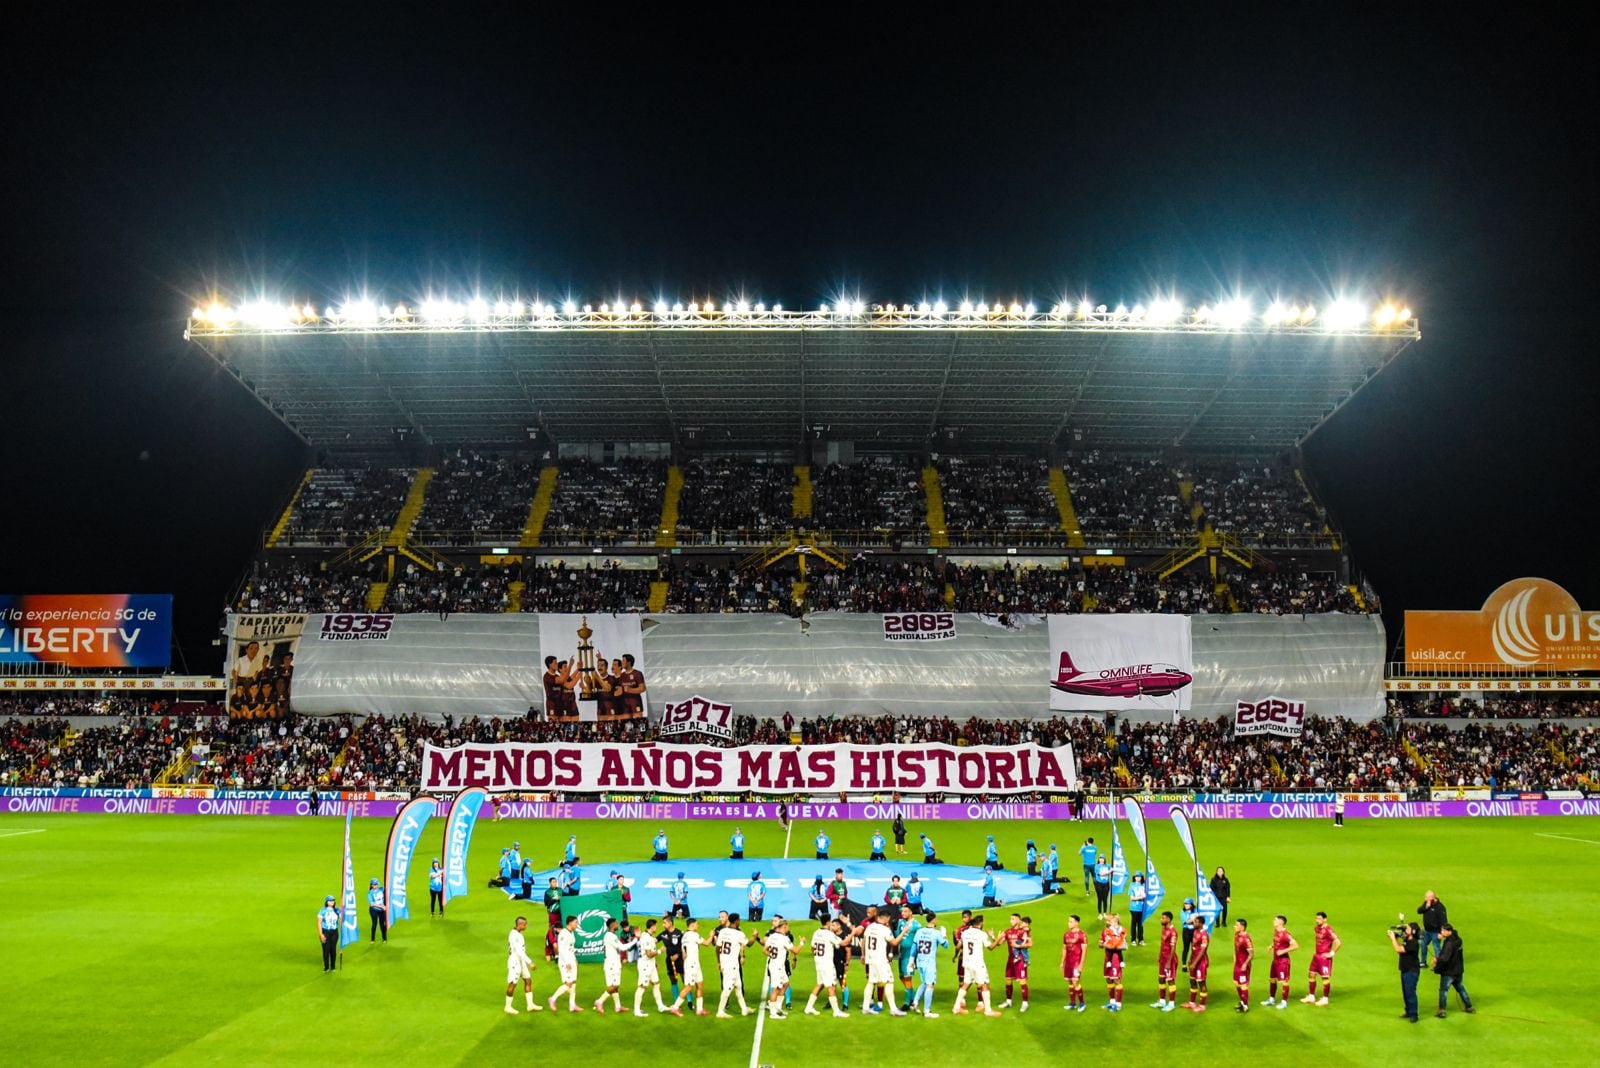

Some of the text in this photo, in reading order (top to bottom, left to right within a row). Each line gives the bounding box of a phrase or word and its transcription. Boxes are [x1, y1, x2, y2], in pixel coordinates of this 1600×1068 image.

[9, 608, 23, 621] la
[26, 608, 112, 624] experiencia
[114, 608, 135, 621] 5G
[138, 608, 157, 621] de
[322, 614, 395, 632] 1935
[884, 613, 954, 632] 2005
[254, 624, 286, 635] LEIVA
[885, 630, 956, 641] MUNDIALISTAS
[1411, 648, 1467, 661] uisil.ac.cr
[1099, 664, 1153, 678] OMNILIFE
[663, 697, 731, 728] 1977
[1237, 699, 1304, 725] 2024
[662, 720, 732, 737] SEIS AL HILO
[427, 749, 582, 787] MENOS
[597, 742, 723, 789] AÑOS
[850, 749, 1068, 789] HISTORIA
[8, 798, 80, 812] OMNILIFE
[103, 798, 176, 814] OMNILIFE
[197, 799, 271, 815] OMNILIFE
[499, 803, 672, 818] OMNILIFE OMNILIFE
[693, 806, 722, 816] ESTA
[726, 807, 740, 816] ES
[743, 806, 766, 818] LA
[863, 804, 941, 819] OMNILIFE
[967, 804, 1044, 819] OMNILIFE
[1269, 804, 1336, 818] OMNILIF
[1368, 803, 1442, 817] OMNILIFE
[1466, 802, 1539, 816] OMNILIFE
[448, 804, 473, 887] LIBERTY
[392, 815, 419, 909] LIBERTY
